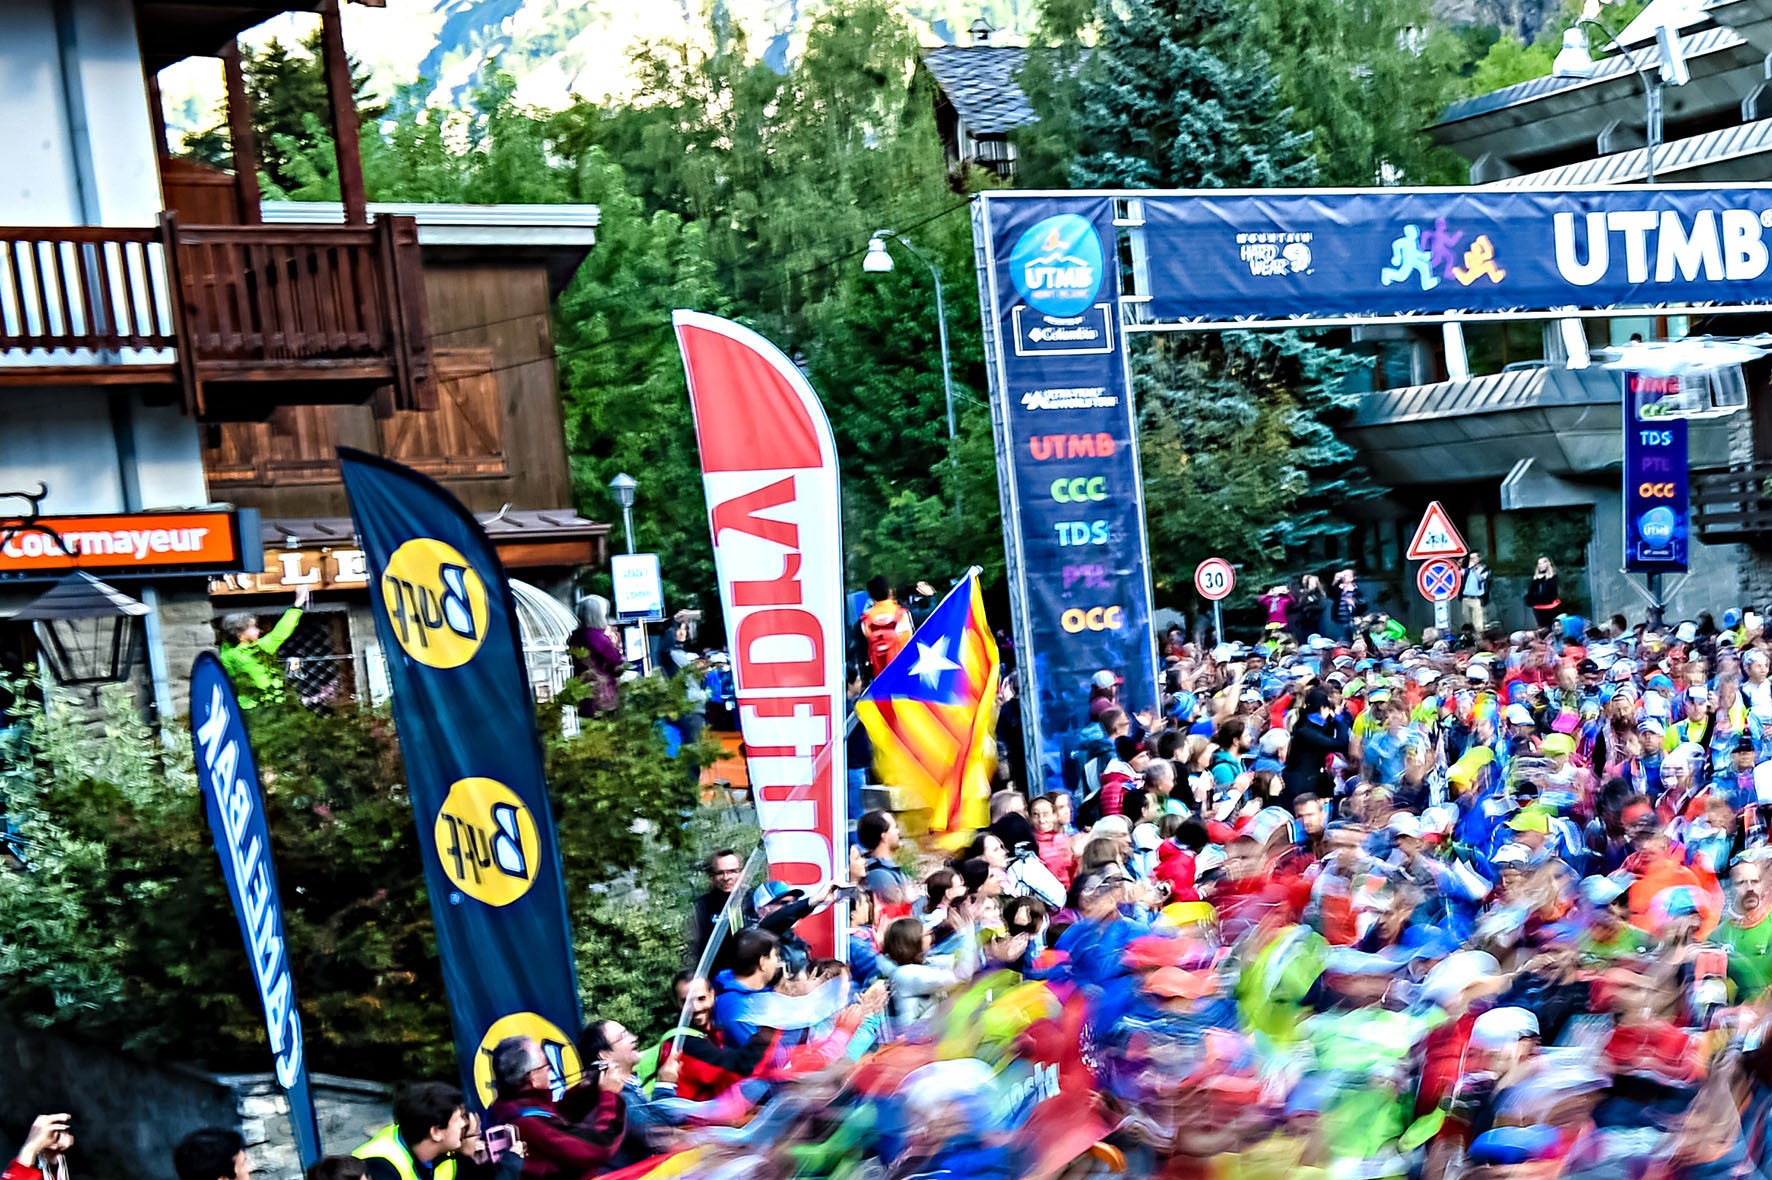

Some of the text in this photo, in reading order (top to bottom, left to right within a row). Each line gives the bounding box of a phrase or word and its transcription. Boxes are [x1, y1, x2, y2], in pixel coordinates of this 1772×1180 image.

[1240, 244, 1279, 262] HARD
[1553, 207, 1769, 286] UTMB
[1024, 267, 1093, 289] UTMB
[1030, 433, 1115, 461] UTMB
[1640, 430, 1672, 446] TDS
[1051, 476, 1107, 503] CCC
[1639, 482, 1676, 498] OCC
[3, 526, 209, 560] Courmayeur
[1054, 520, 1109, 546] TDS
[1205, 572, 1224, 590] 30
[1061, 605, 1122, 633] OCC
